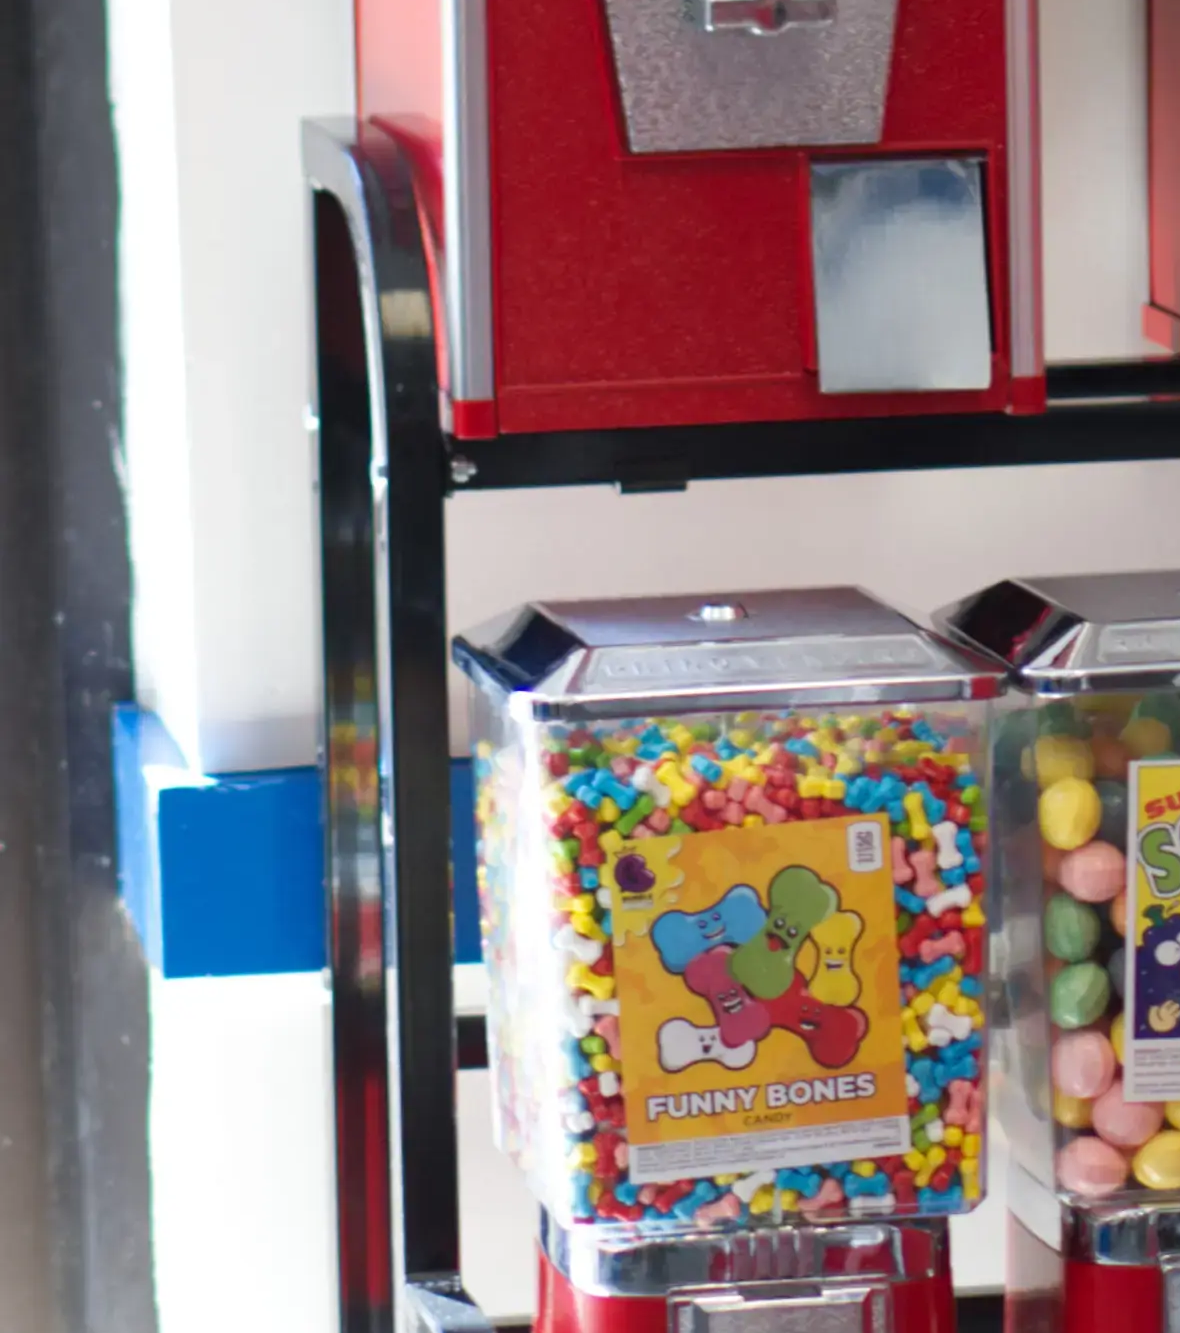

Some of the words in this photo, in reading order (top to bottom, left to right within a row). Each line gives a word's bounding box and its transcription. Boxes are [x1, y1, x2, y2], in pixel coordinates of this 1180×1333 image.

[647, 1085, 760, 1122] FUNNY
[765, 1073, 876, 1109] BONES
[743, 1112, 793, 1127] CANDY
